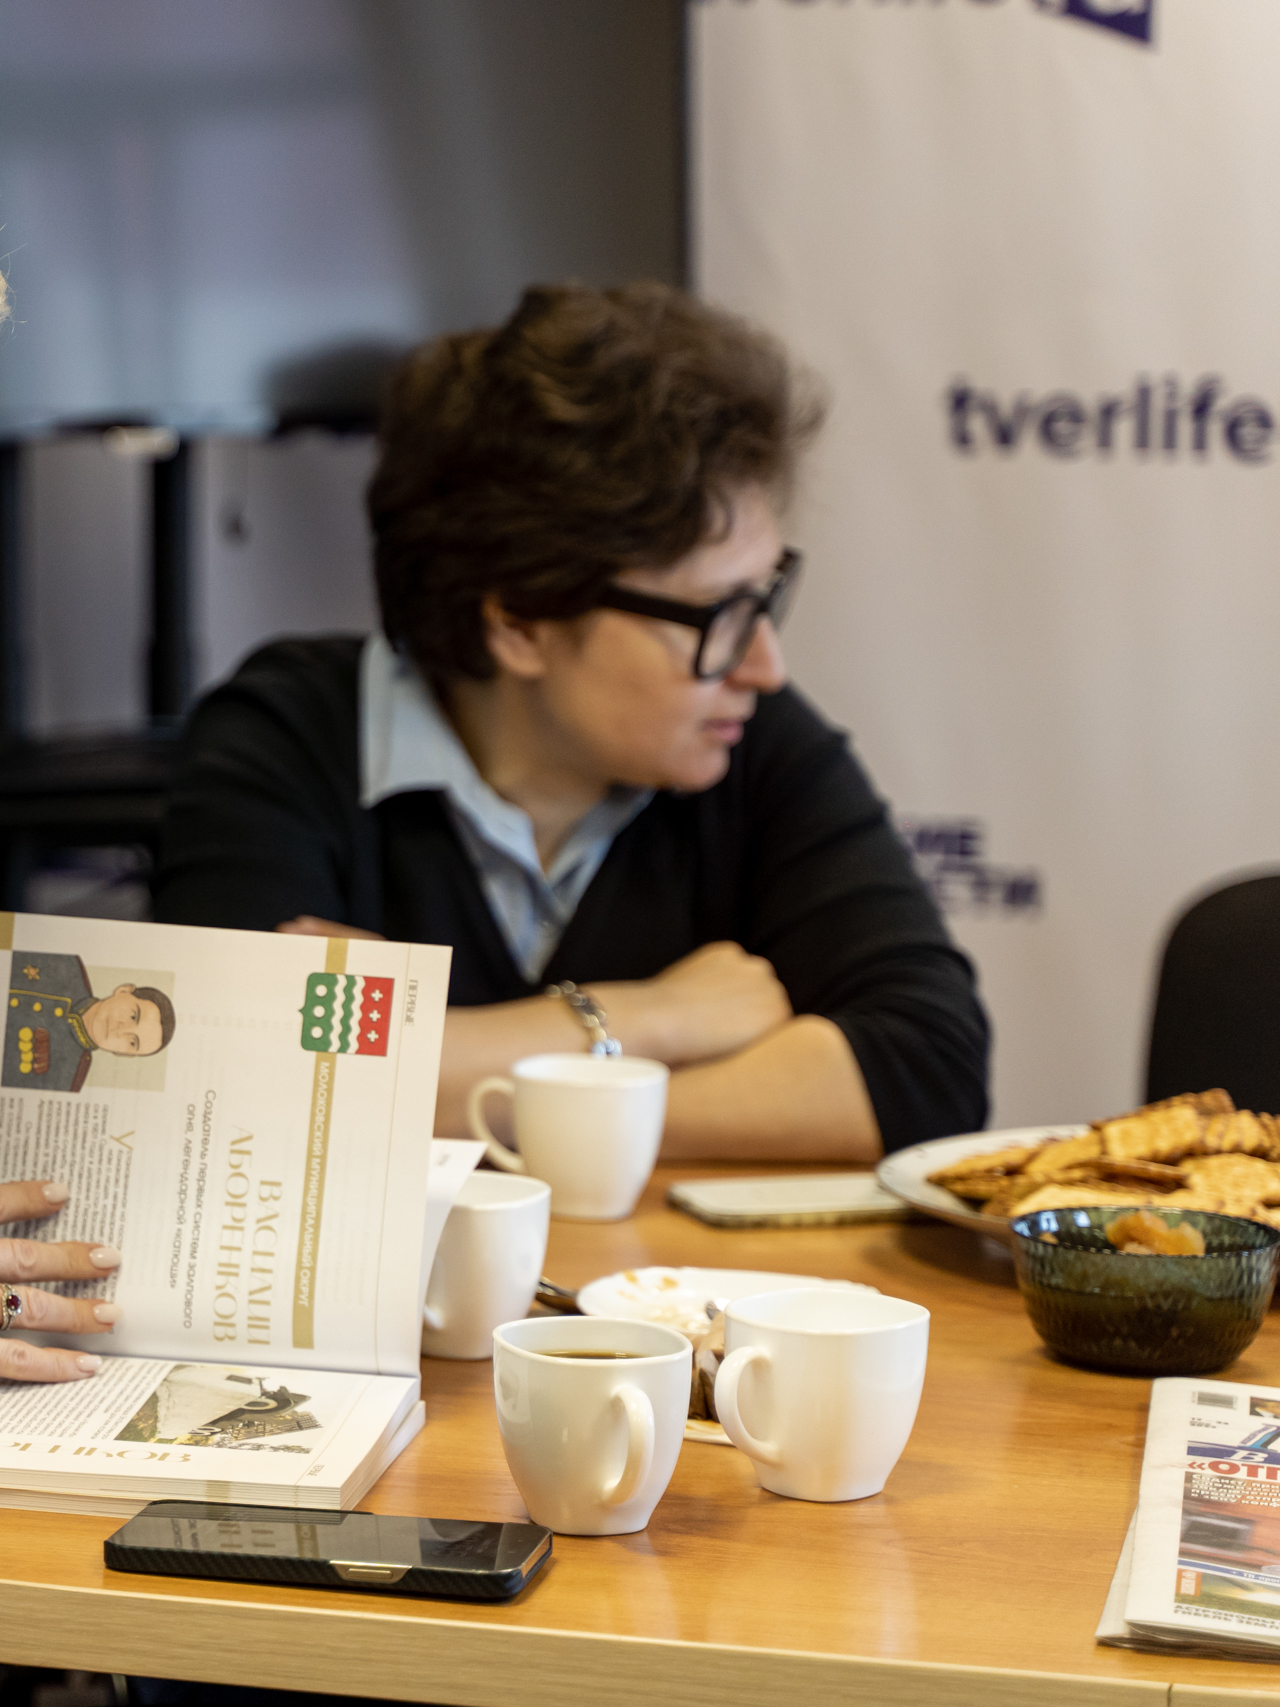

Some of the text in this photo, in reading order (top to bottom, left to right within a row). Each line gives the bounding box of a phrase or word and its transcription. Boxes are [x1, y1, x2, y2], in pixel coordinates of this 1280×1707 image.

[947, 376, 1276, 464] tverlife
[169, 1103, 196, 1289] огня, легендарной «катюши»
[182, 1089, 217, 1330] Создатель первых систем залпового
[212, 1125, 254, 1343] АБОРЕНКОВ
[247, 1180, 281, 1345] ВАСИЛИЙ
[299, 1062, 329, 1306] МОЛОКОВСКИЙ МУНИЦИПАЛЬНЫЙ ОКРУГ
[1192, 1484, 1280, 1497] заключени
